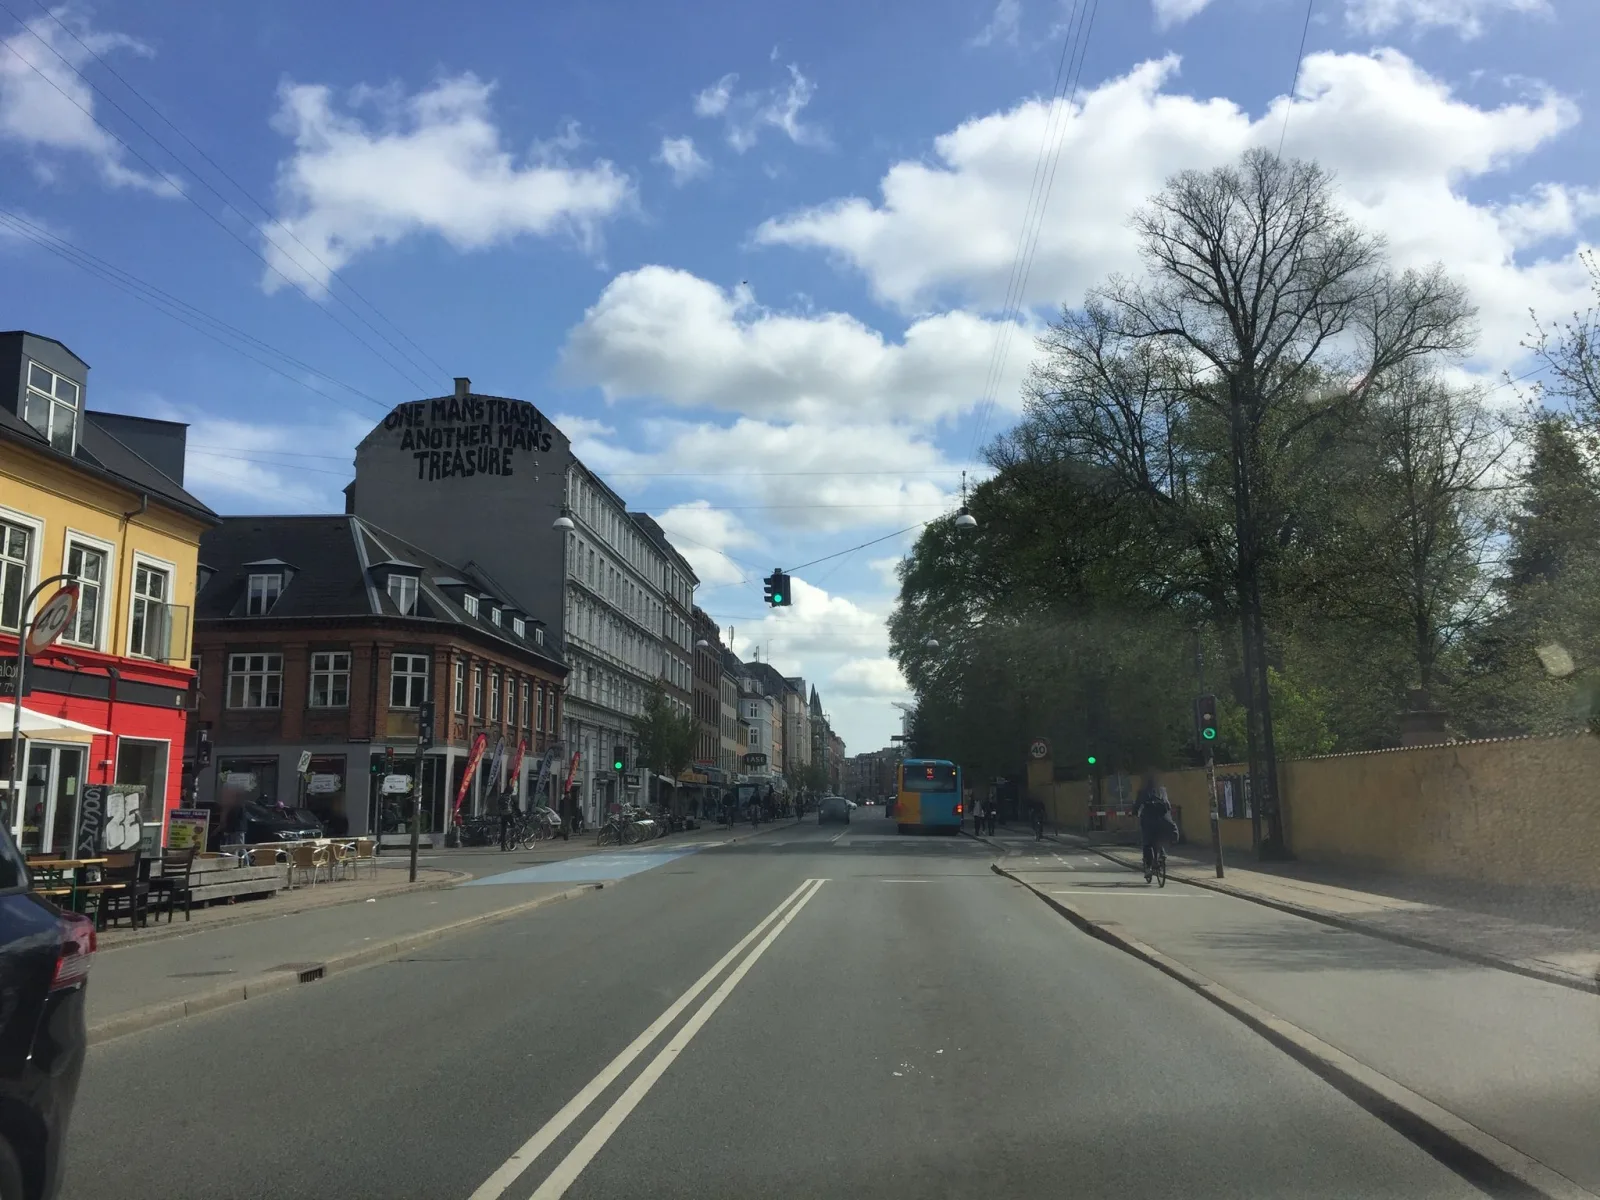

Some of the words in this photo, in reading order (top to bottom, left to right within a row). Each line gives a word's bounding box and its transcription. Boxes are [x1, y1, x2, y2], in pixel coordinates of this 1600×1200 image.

[384, 403, 425, 431] ONE
[486, 400, 543, 432] TRASH
[401, 424, 493, 451] ANOTHER
[413, 445, 514, 482] TREASURE
[36, 604, 68, 632] 40
[1031, 745, 1046, 755] 40
